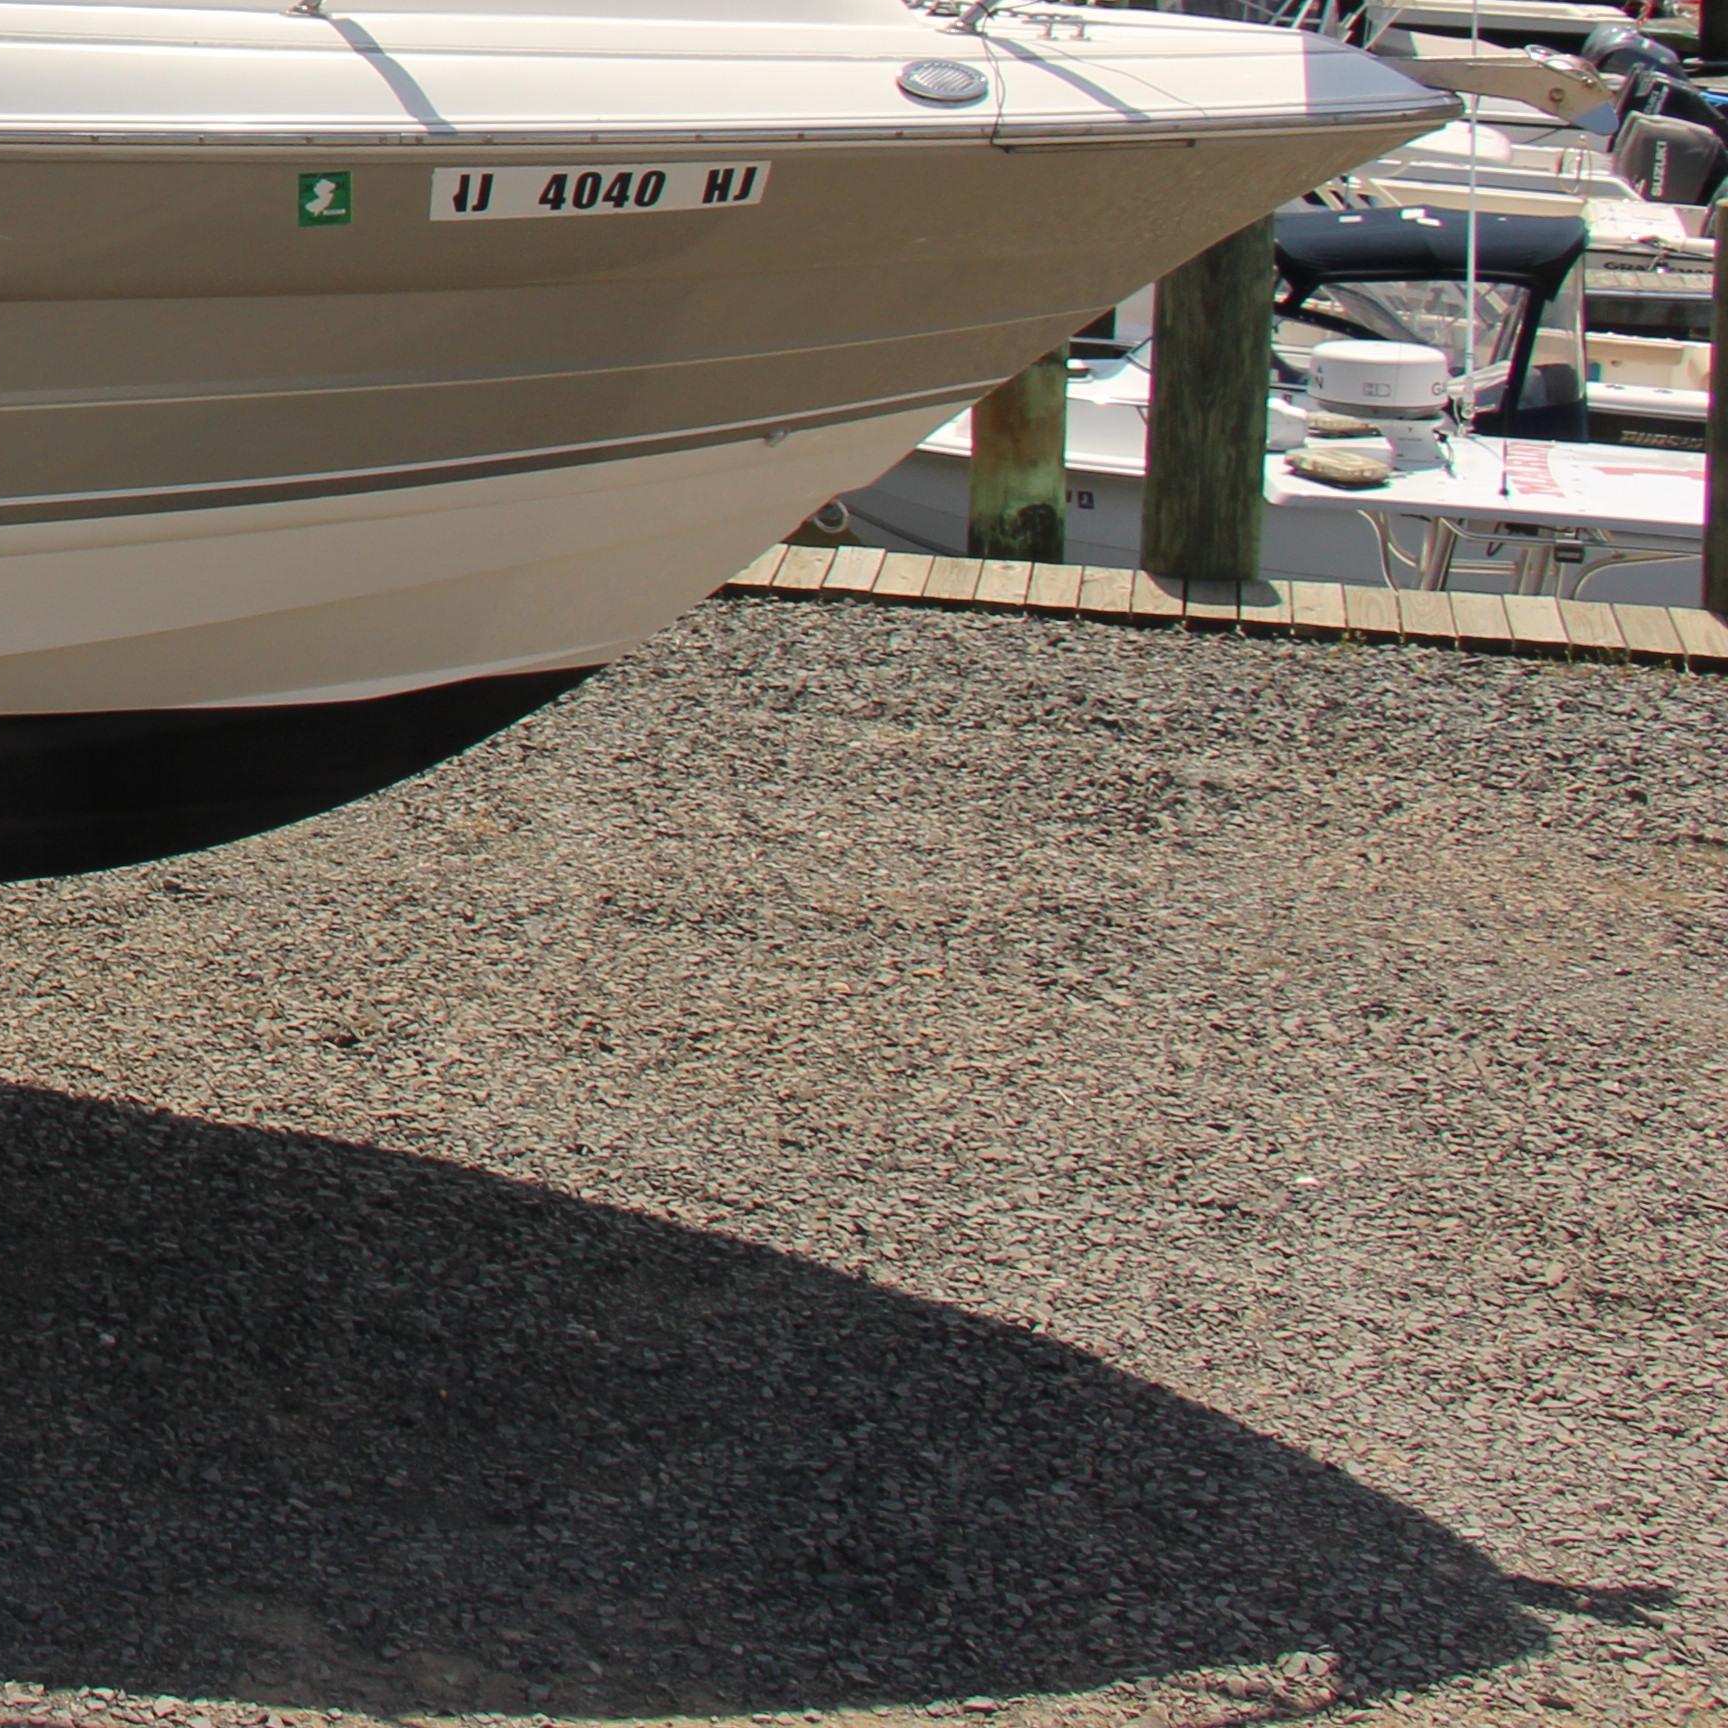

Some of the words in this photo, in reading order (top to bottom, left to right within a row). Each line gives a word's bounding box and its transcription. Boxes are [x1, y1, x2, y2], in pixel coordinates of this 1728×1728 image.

[538, 170, 666, 211] 4040
[702, 166, 758, 204] HJ
[1651, 140, 1667, 198] SUZUKI
